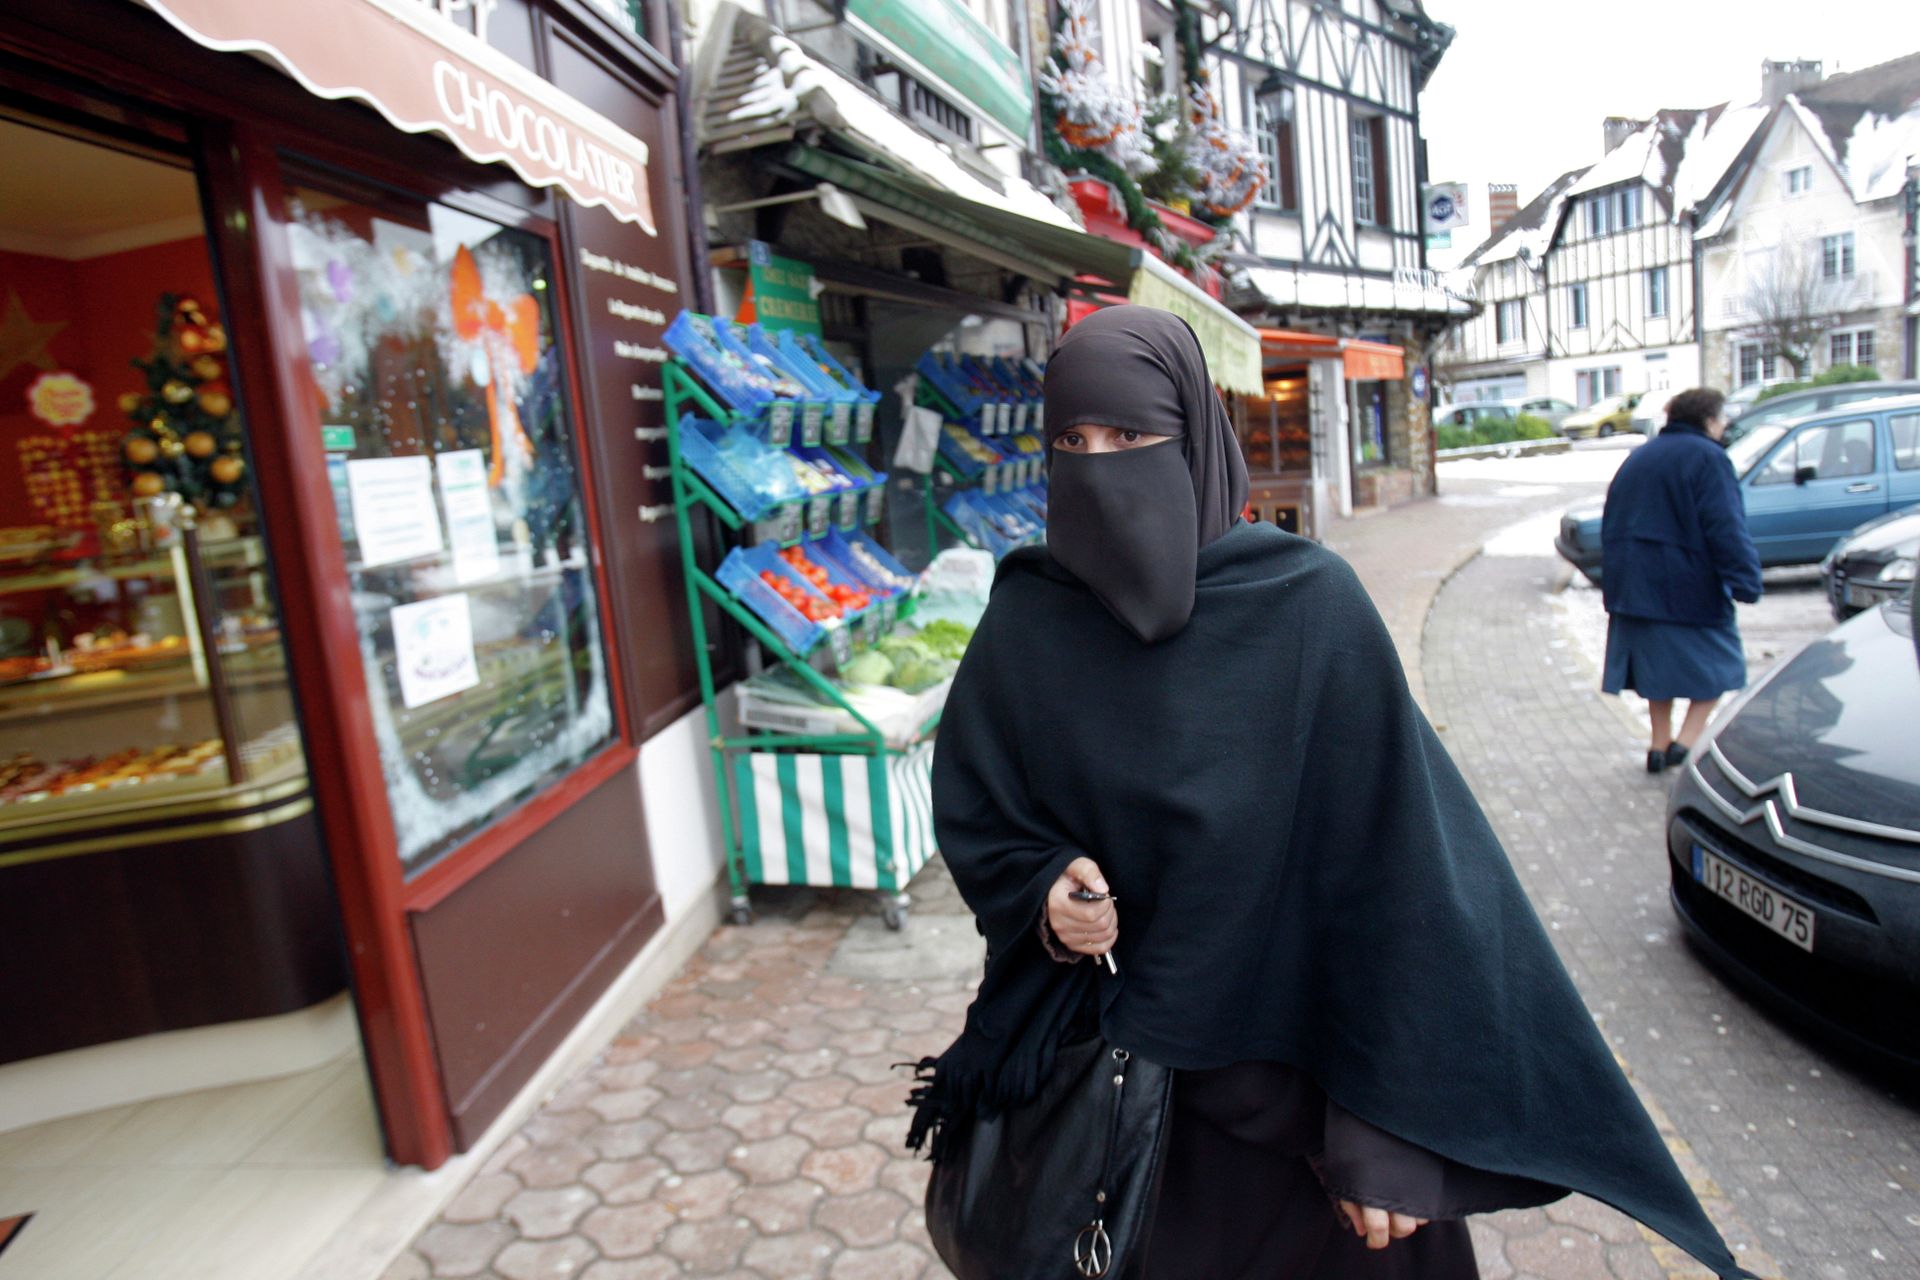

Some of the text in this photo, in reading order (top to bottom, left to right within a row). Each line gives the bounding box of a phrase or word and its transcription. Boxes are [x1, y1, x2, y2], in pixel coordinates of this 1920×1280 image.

[433, 59, 640, 208] CHOCOLATIER
[1704, 856, 1809, 943] 112 RGD 75
